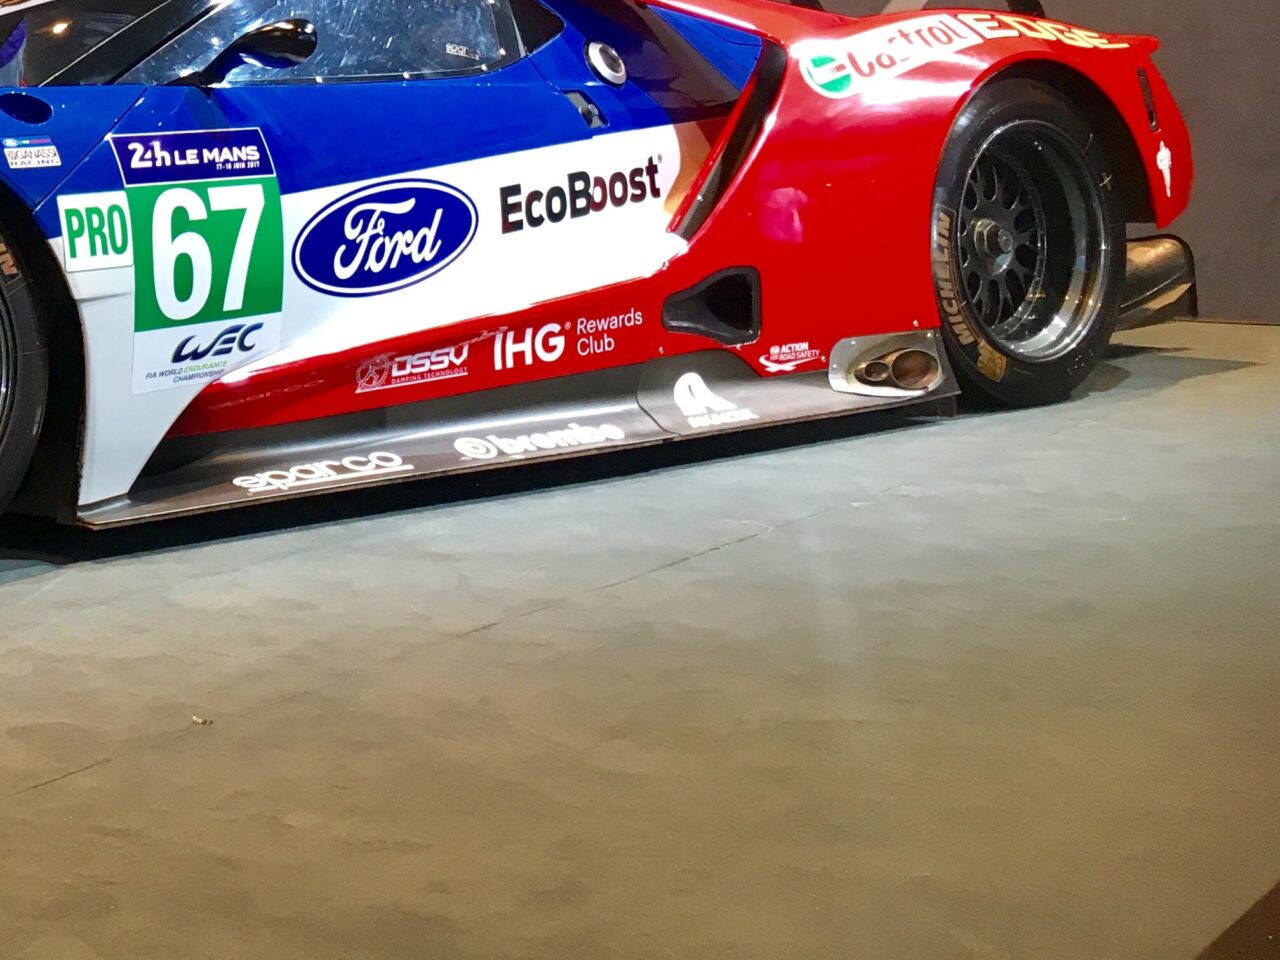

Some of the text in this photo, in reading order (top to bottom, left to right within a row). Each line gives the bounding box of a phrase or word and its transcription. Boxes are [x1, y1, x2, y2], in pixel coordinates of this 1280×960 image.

[957, 13, 1131, 50] EDGE
[174, 149, 200, 165] LE
[202, 145, 260, 164] MANS
[64, 204, 129, 259] PRO
[333, 197, 444, 280] Ford
[151, 184, 265, 321] 67
[576, 308, 644, 335] Rewards
[170, 322, 265, 364] WEC
[576, 341, 616, 357] Club
[781, 342, 809, 353] ACTION
[797, 349, 820, 359] SAFETY
[145, 371, 157, 380] FIA
[158, 368, 183, 377] WORLD
[391, 344, 469, 376] DSSV
[391, 367, 468, 384] DAMPING TECHNOLOGY
[493, 423, 626, 455] brembo
[233, 451, 404, 491] sparco
